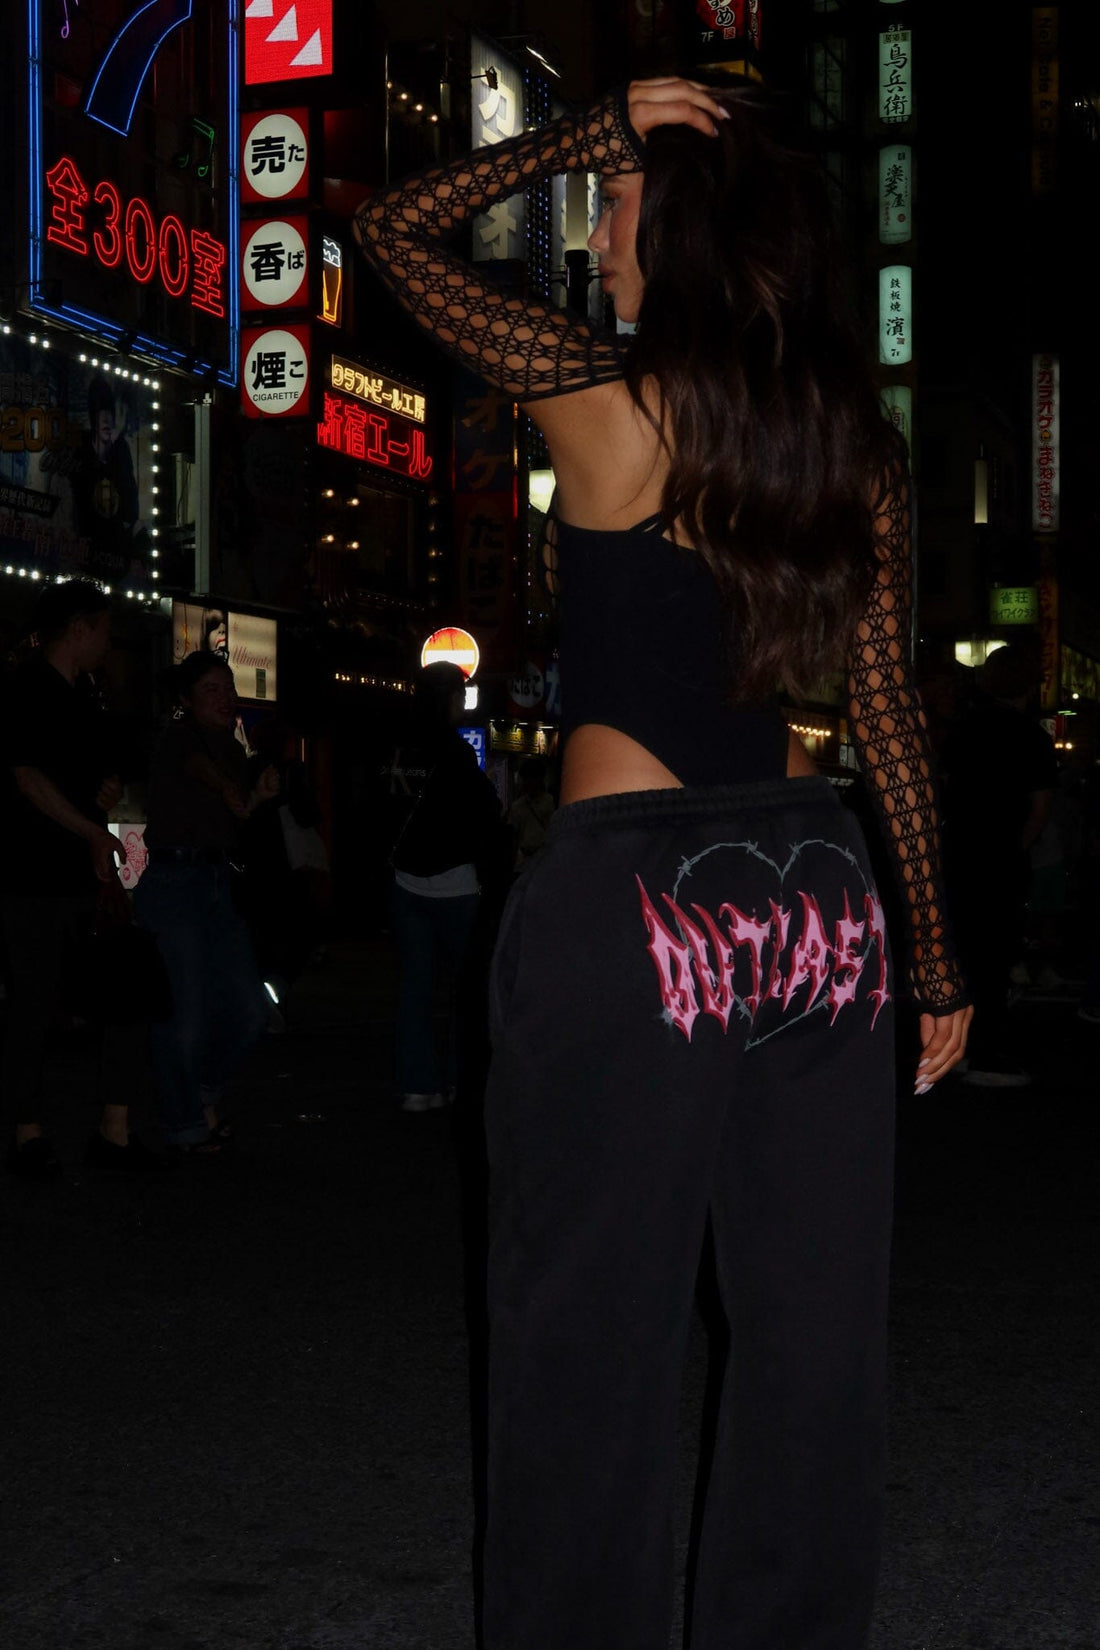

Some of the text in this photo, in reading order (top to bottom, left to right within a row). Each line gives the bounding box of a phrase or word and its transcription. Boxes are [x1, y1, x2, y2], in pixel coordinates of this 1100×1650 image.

[46, 157, 225, 318] 全300室
[252, 391, 299, 401] CIGARETTE
[333, 363, 426, 422] クラフトビール工房
[317, 391, 433, 477] 新宿エール
